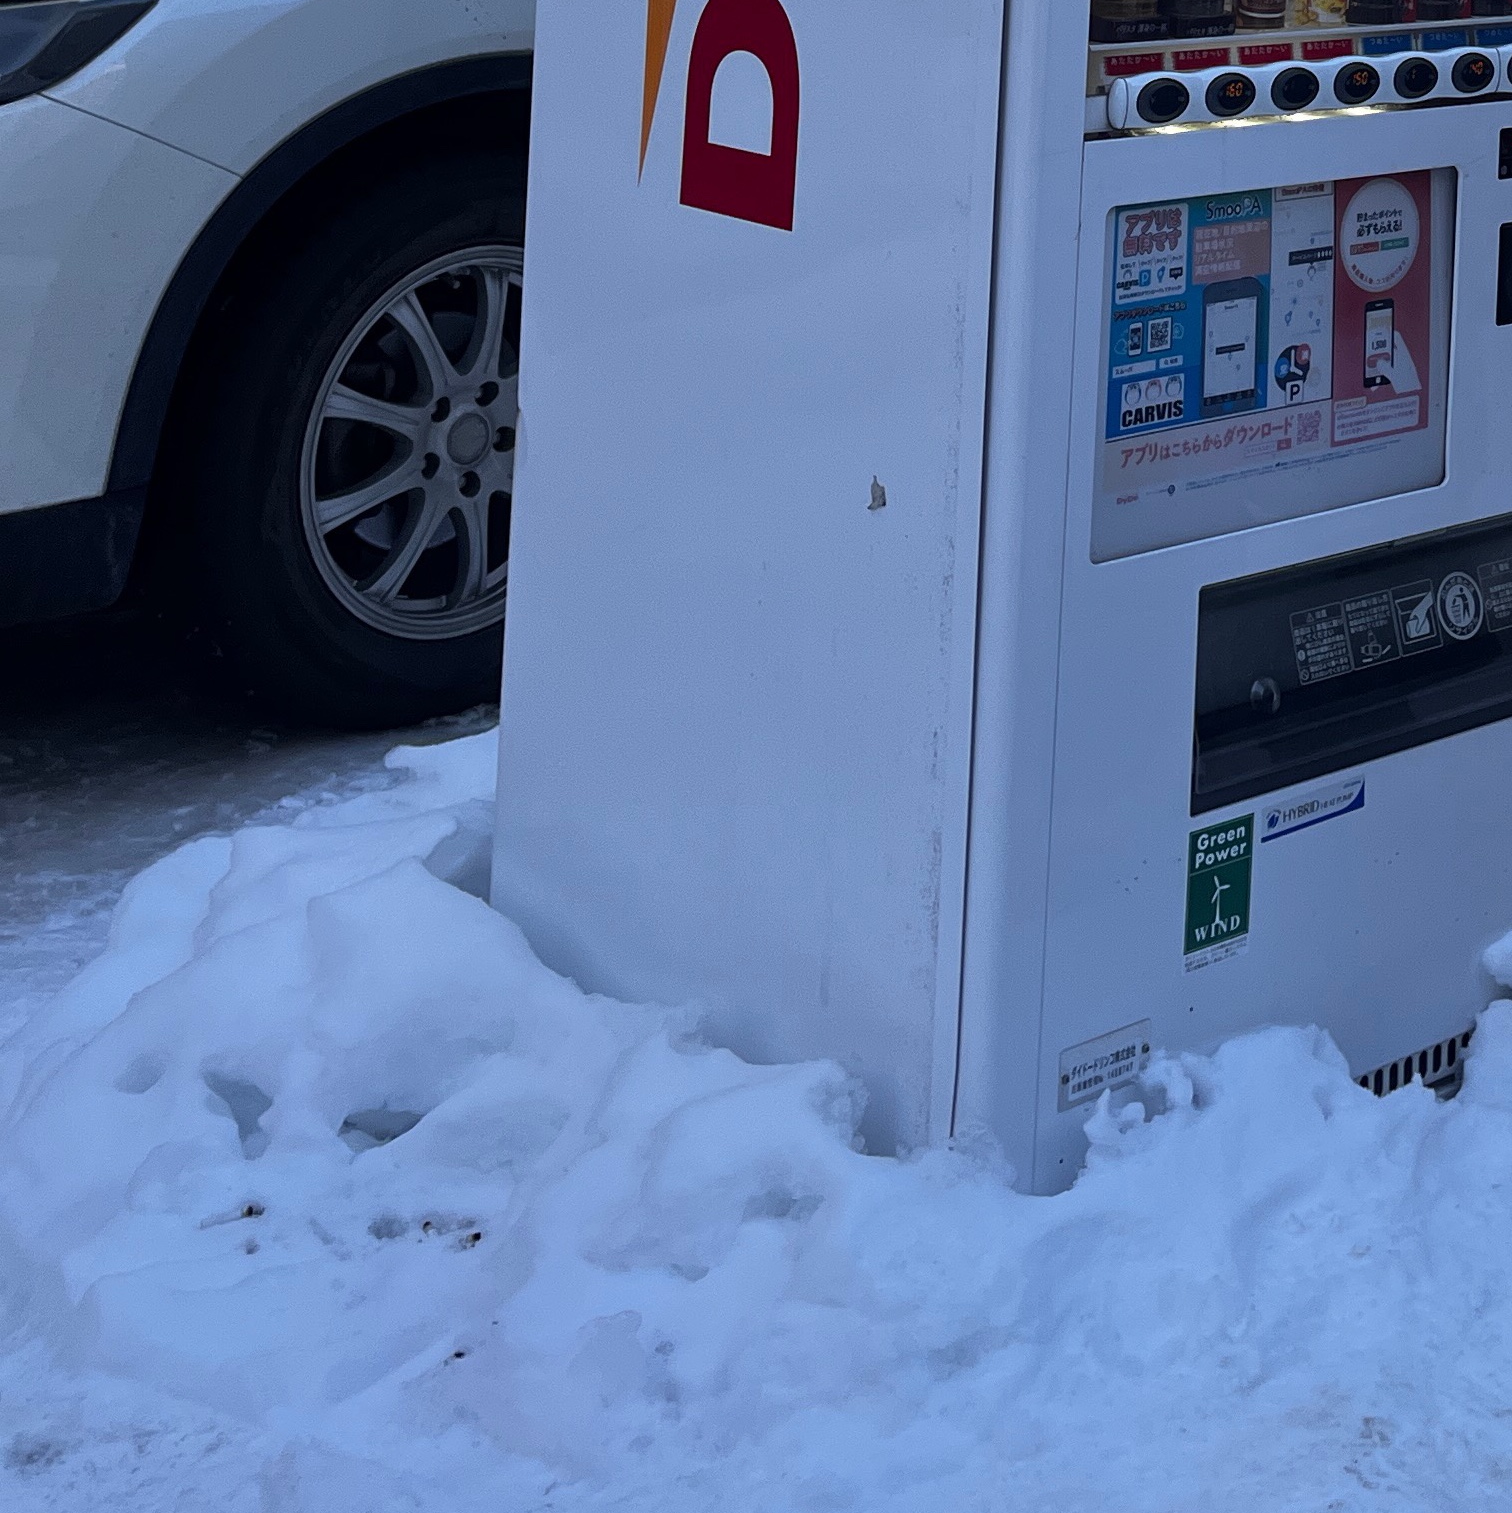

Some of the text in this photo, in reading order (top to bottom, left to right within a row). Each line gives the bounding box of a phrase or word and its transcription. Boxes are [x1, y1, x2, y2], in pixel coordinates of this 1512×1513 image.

[1124, 208, 1183, 235] アプリは
[1205, 196, 1262, 221] SmooPA
[1356, 220, 1403, 237] 必ずもらえる!
[1122, 229, 1183, 258] 無料です
[1121, 399, 1183, 428] CARVIS
[1120, 414, 1295, 469] アプリはこちらからダウンロード
[1282, 799, 1320, 824] HYBRID
[1197, 824, 1246, 851] Green
[1194, 841, 1247, 870] Power
[1194, 914, 1242, 943] WIND
